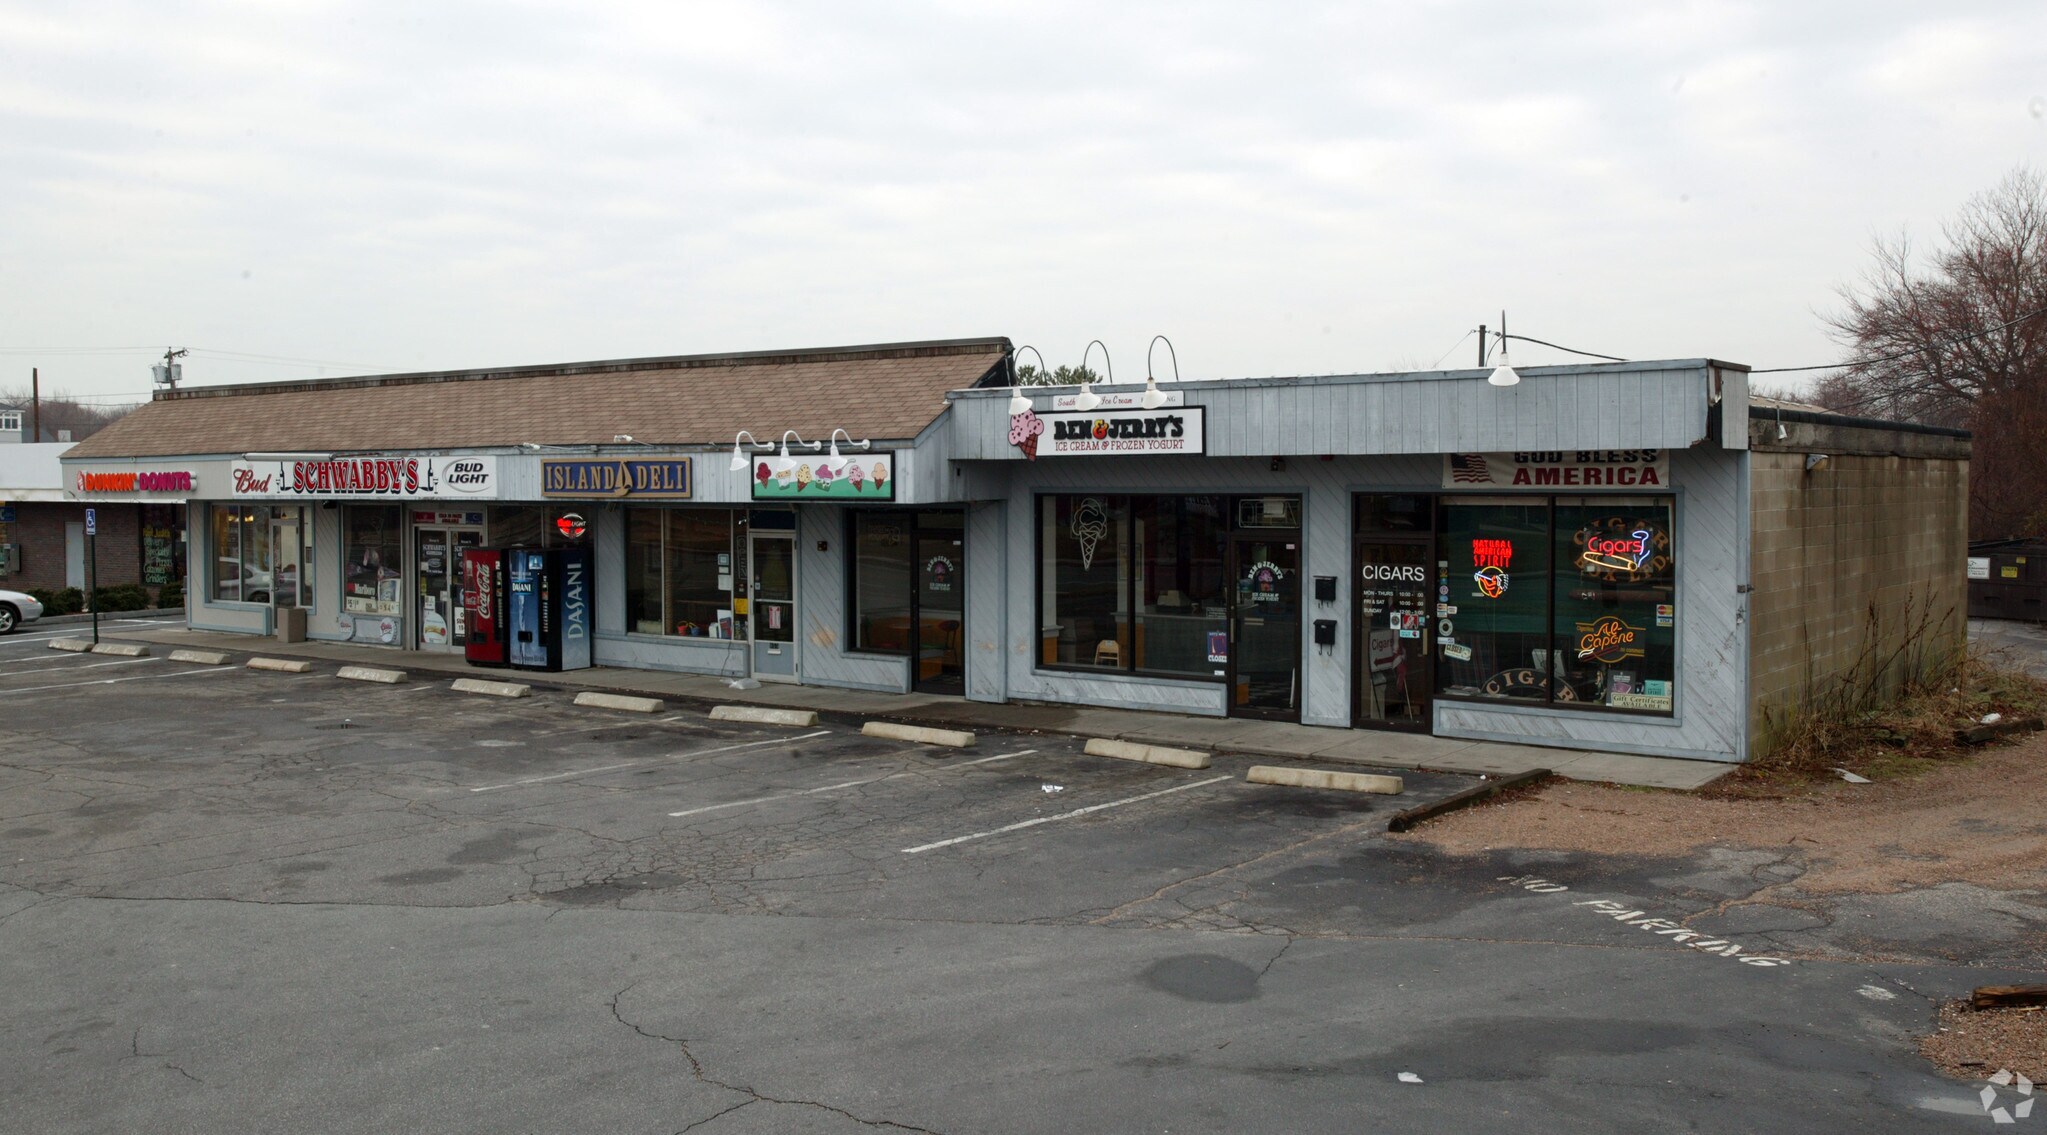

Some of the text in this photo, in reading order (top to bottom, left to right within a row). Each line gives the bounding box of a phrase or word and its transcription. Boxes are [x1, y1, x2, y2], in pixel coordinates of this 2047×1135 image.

[1057, 397, 1076, 407] South
[1100, 396, 1112, 405] Ice
[1112, 395, 1133, 405] Cream
[1053, 414, 1184, 440] BEN & JERRY'S
[1055, 441, 1068, 451] ICE
[1069, 440, 1100, 451] CREAM
[1110, 439, 1145, 451] FROZEN
[1147, 439, 1185, 450] YOGURT
[1513, 448, 1659, 464] GOD BLESS
[292, 457, 420, 495] SCHWABBY'S
[453, 462, 485, 474] BUD
[546, 464, 684, 490] ISLAND DELI
[1511, 466, 1660, 486] AMERICA
[85, 470, 192, 492] DUNKIN' DONUTS
[233, 467, 273, 494] Bud
[447, 473, 490, 485] LIGHT
[1472, 539, 1513, 548] NATURAL
[1587, 536, 1643, 556] Cigars
[1473, 555, 1510, 568] SPIRIT
[1247, 563, 1259, 580] BEN
[1362, 565, 1425, 581] CIGARS
[565, 562, 585, 639] DASANI
[1580, 631, 1635, 651] Capone
[1613, 694, 1669, 706] Gift Certificates
[1571, 899, 1791, 967] PARKING
